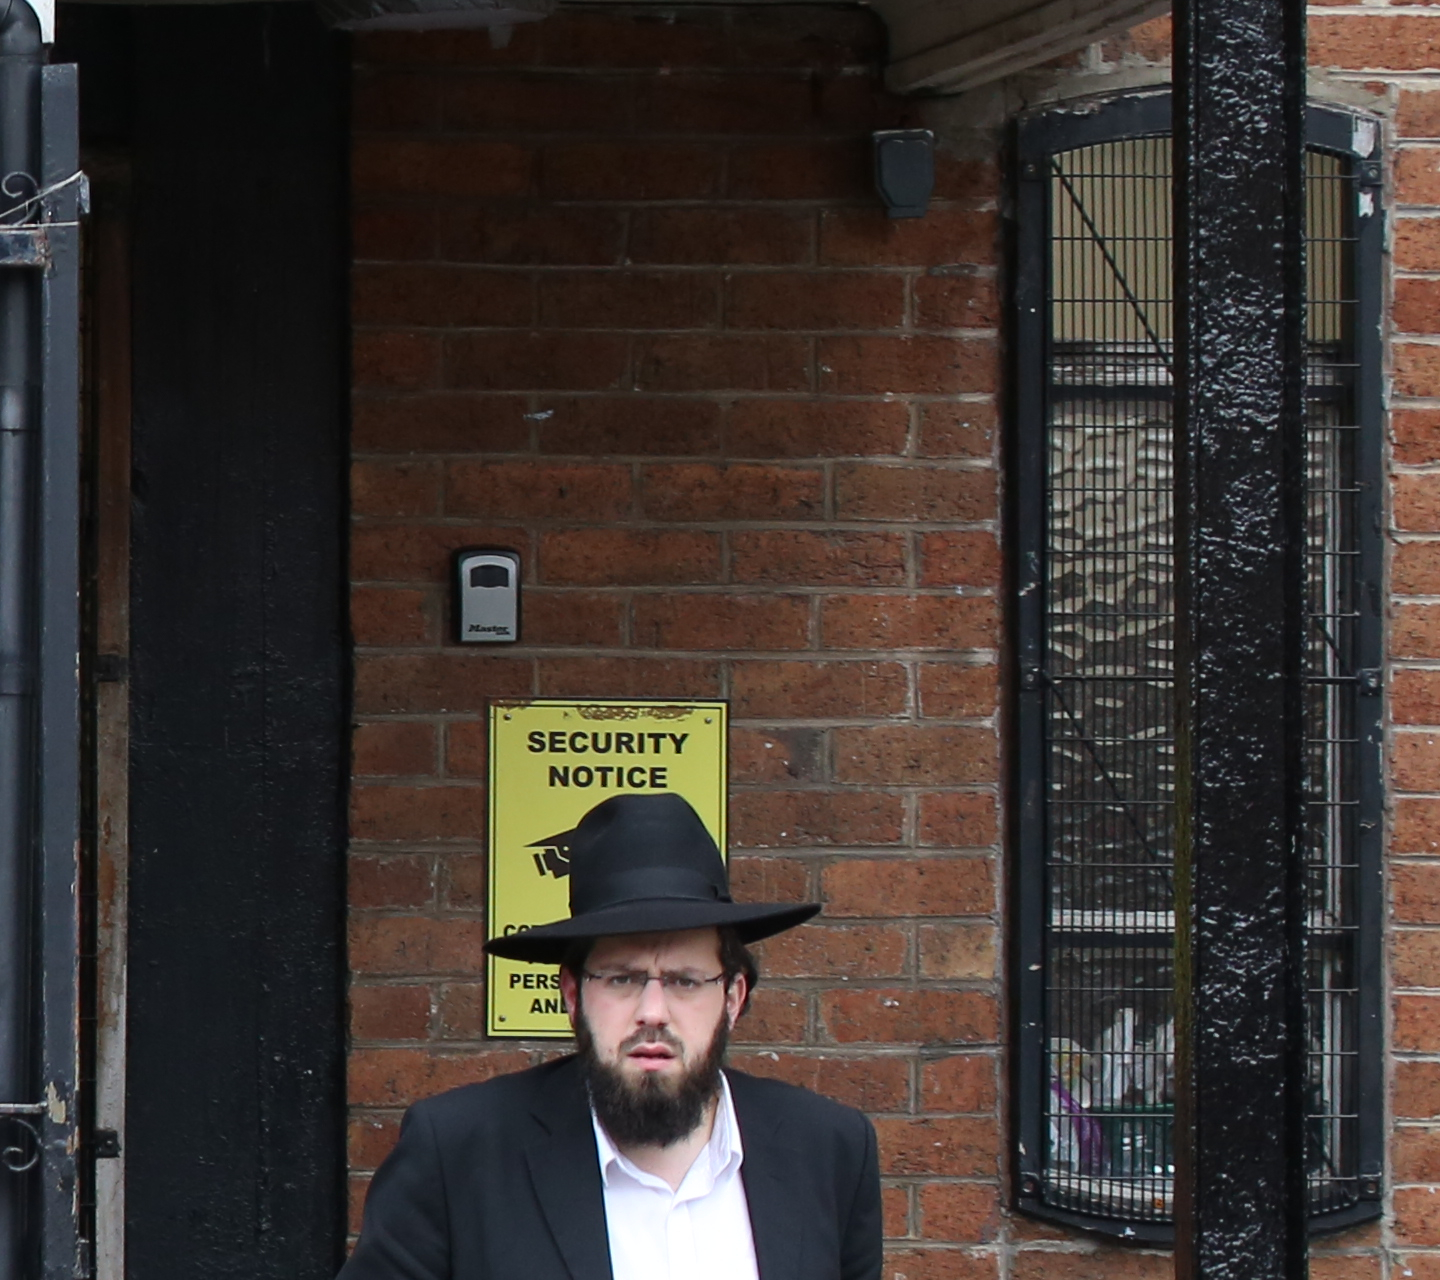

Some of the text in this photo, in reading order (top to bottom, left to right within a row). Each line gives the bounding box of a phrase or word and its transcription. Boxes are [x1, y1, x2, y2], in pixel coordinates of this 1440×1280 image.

[527, 730, 690, 755] SECURITY
[548, 765, 668, 789] NOTICE
[509, 973, 561, 990] PERS
